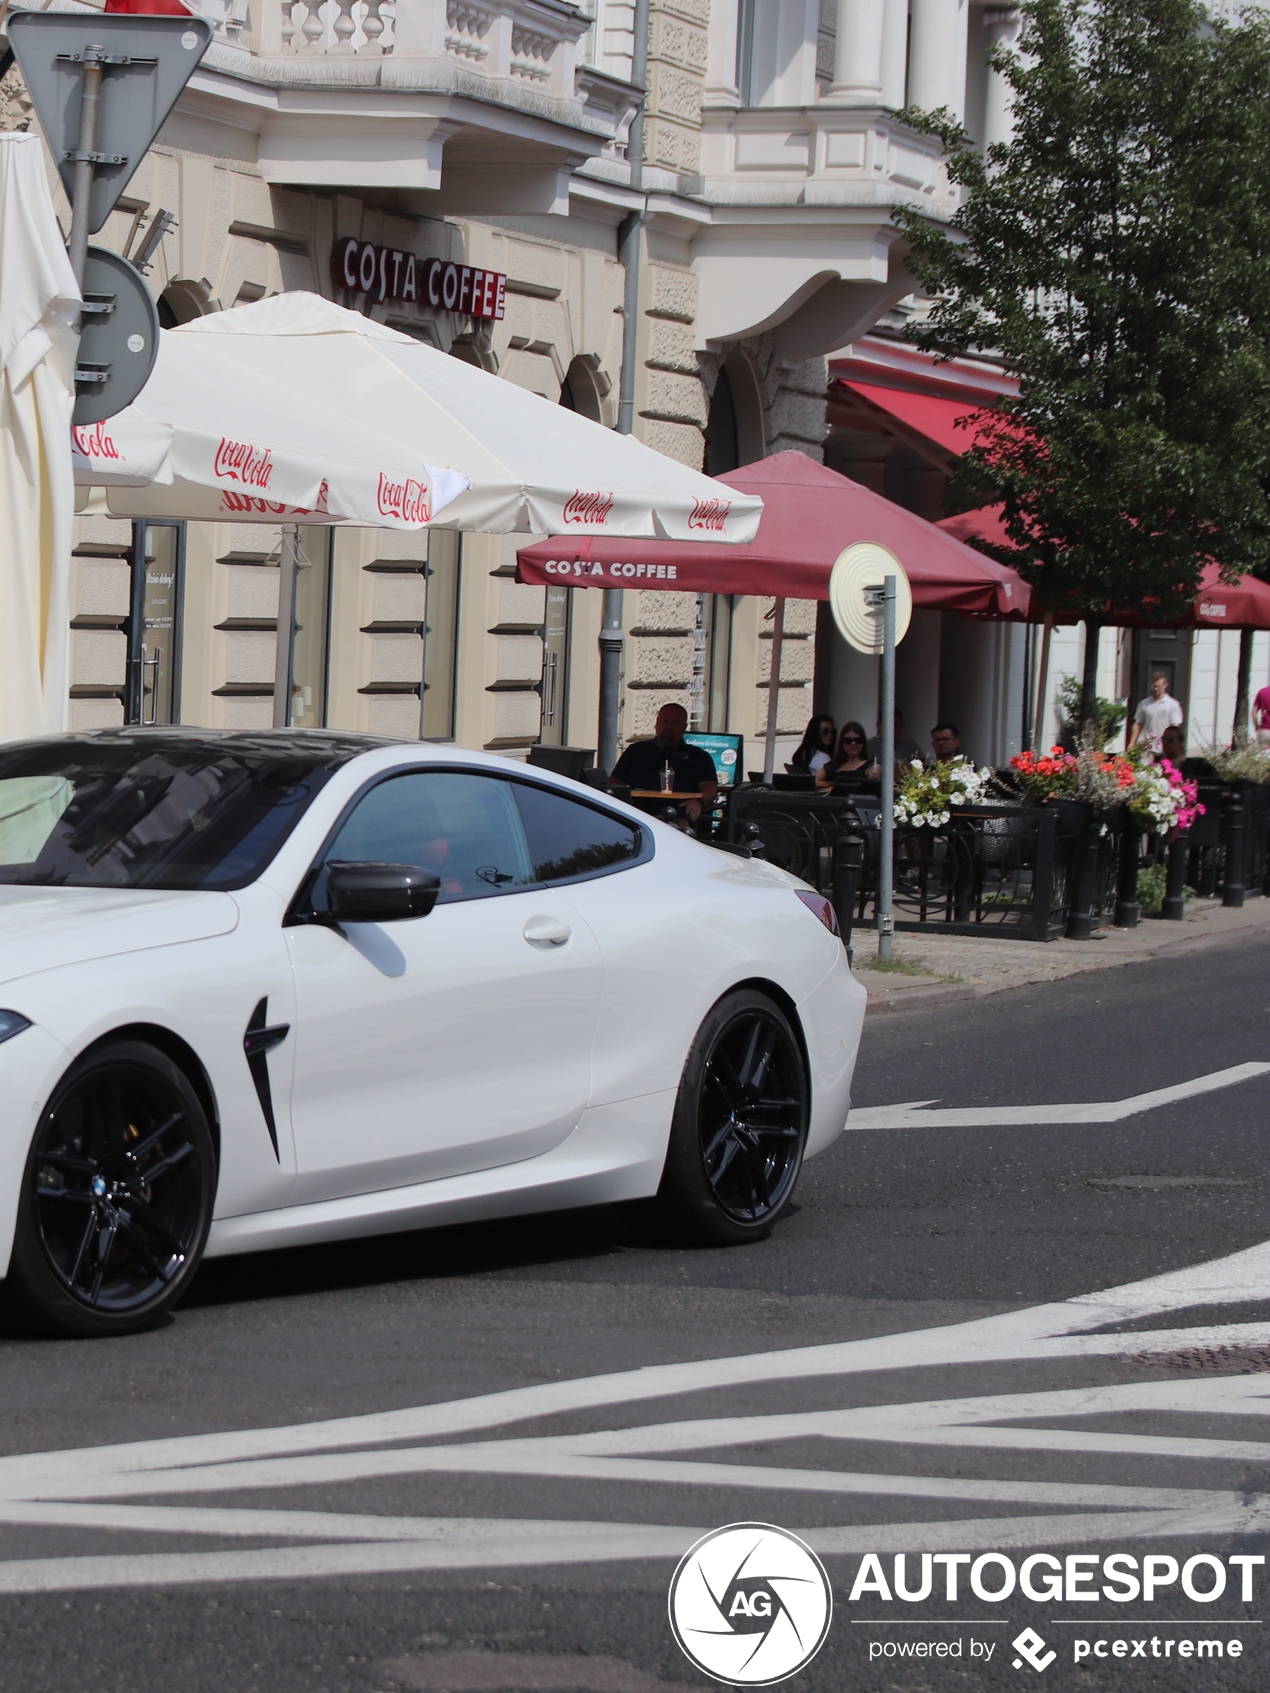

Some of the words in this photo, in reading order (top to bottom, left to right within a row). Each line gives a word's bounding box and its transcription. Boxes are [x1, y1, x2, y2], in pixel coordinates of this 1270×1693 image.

[343, 239, 416, 302] COSTA
[428, 260, 507, 319] COFFEE
[214, 436, 273, 488] Coca-Cola
[377, 471, 431, 522] Coca-Cola
[610, 562, 678, 579] COFFEE
